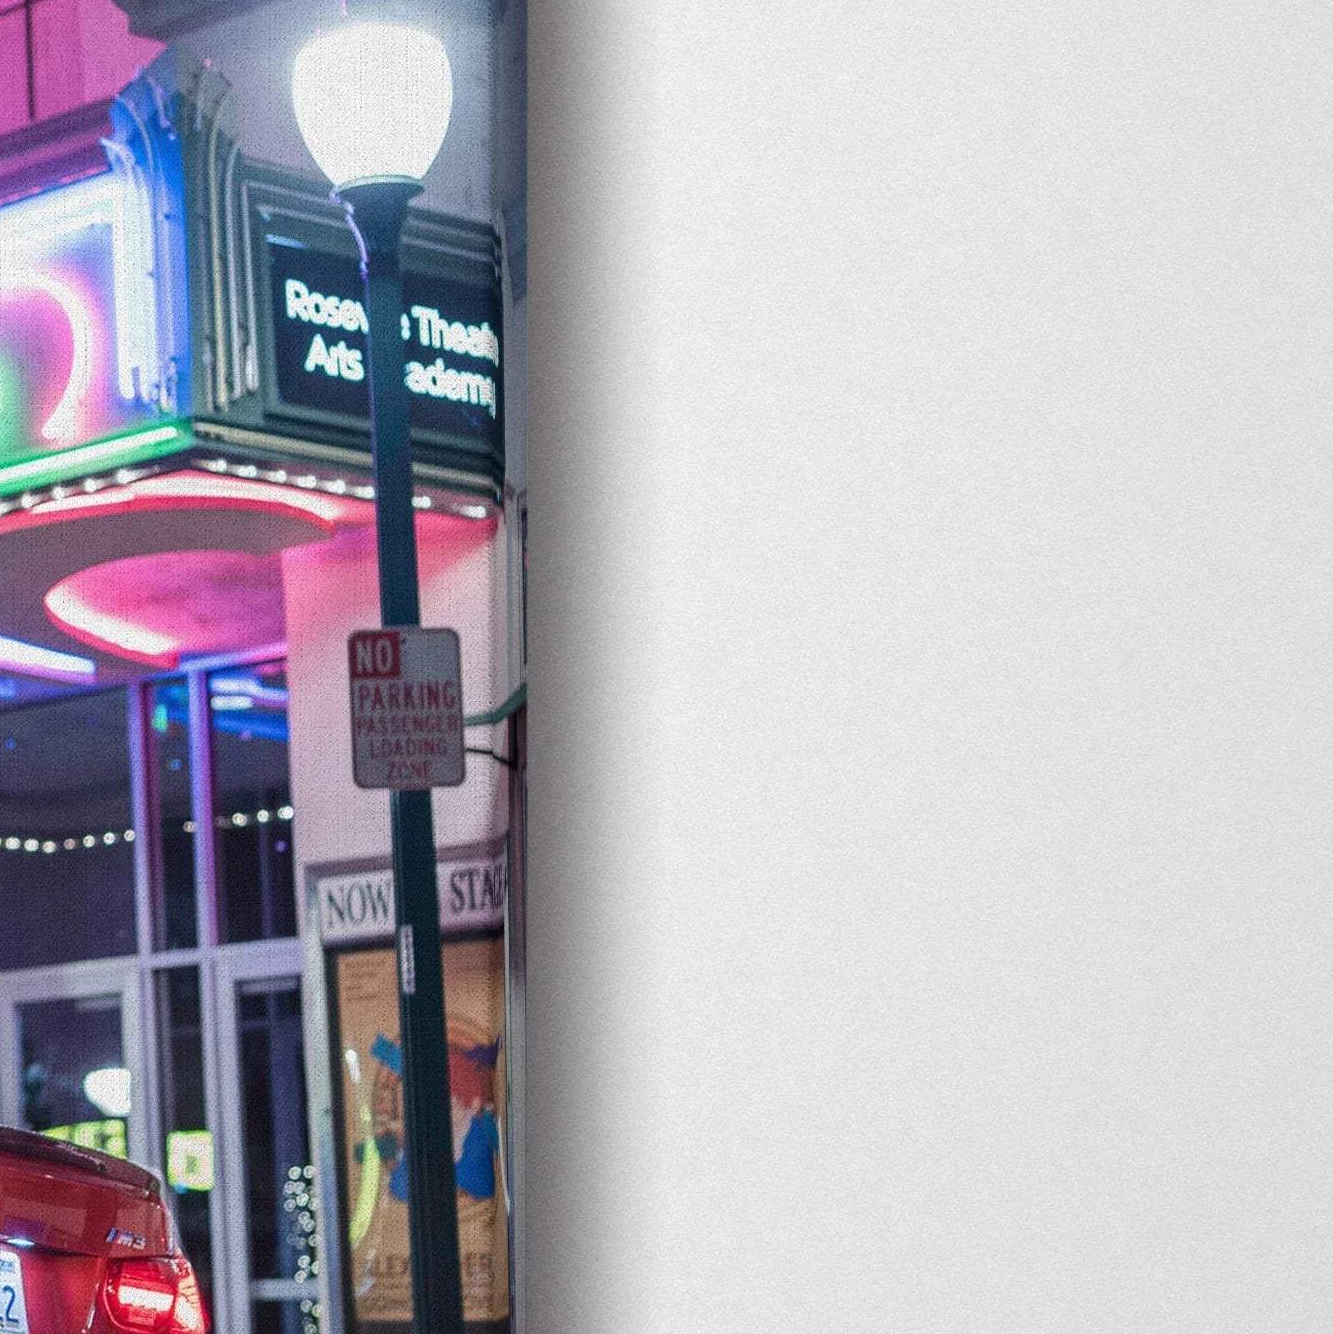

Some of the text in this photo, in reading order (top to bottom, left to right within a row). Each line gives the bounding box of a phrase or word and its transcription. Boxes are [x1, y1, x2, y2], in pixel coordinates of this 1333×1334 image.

[304, 333, 365, 382] Arts
[355, 639, 394, 674] NO
[357, 681, 455, 713] PARKING
[370, 737, 448, 760] LOADING
[326, 878, 391, 927] NOW
